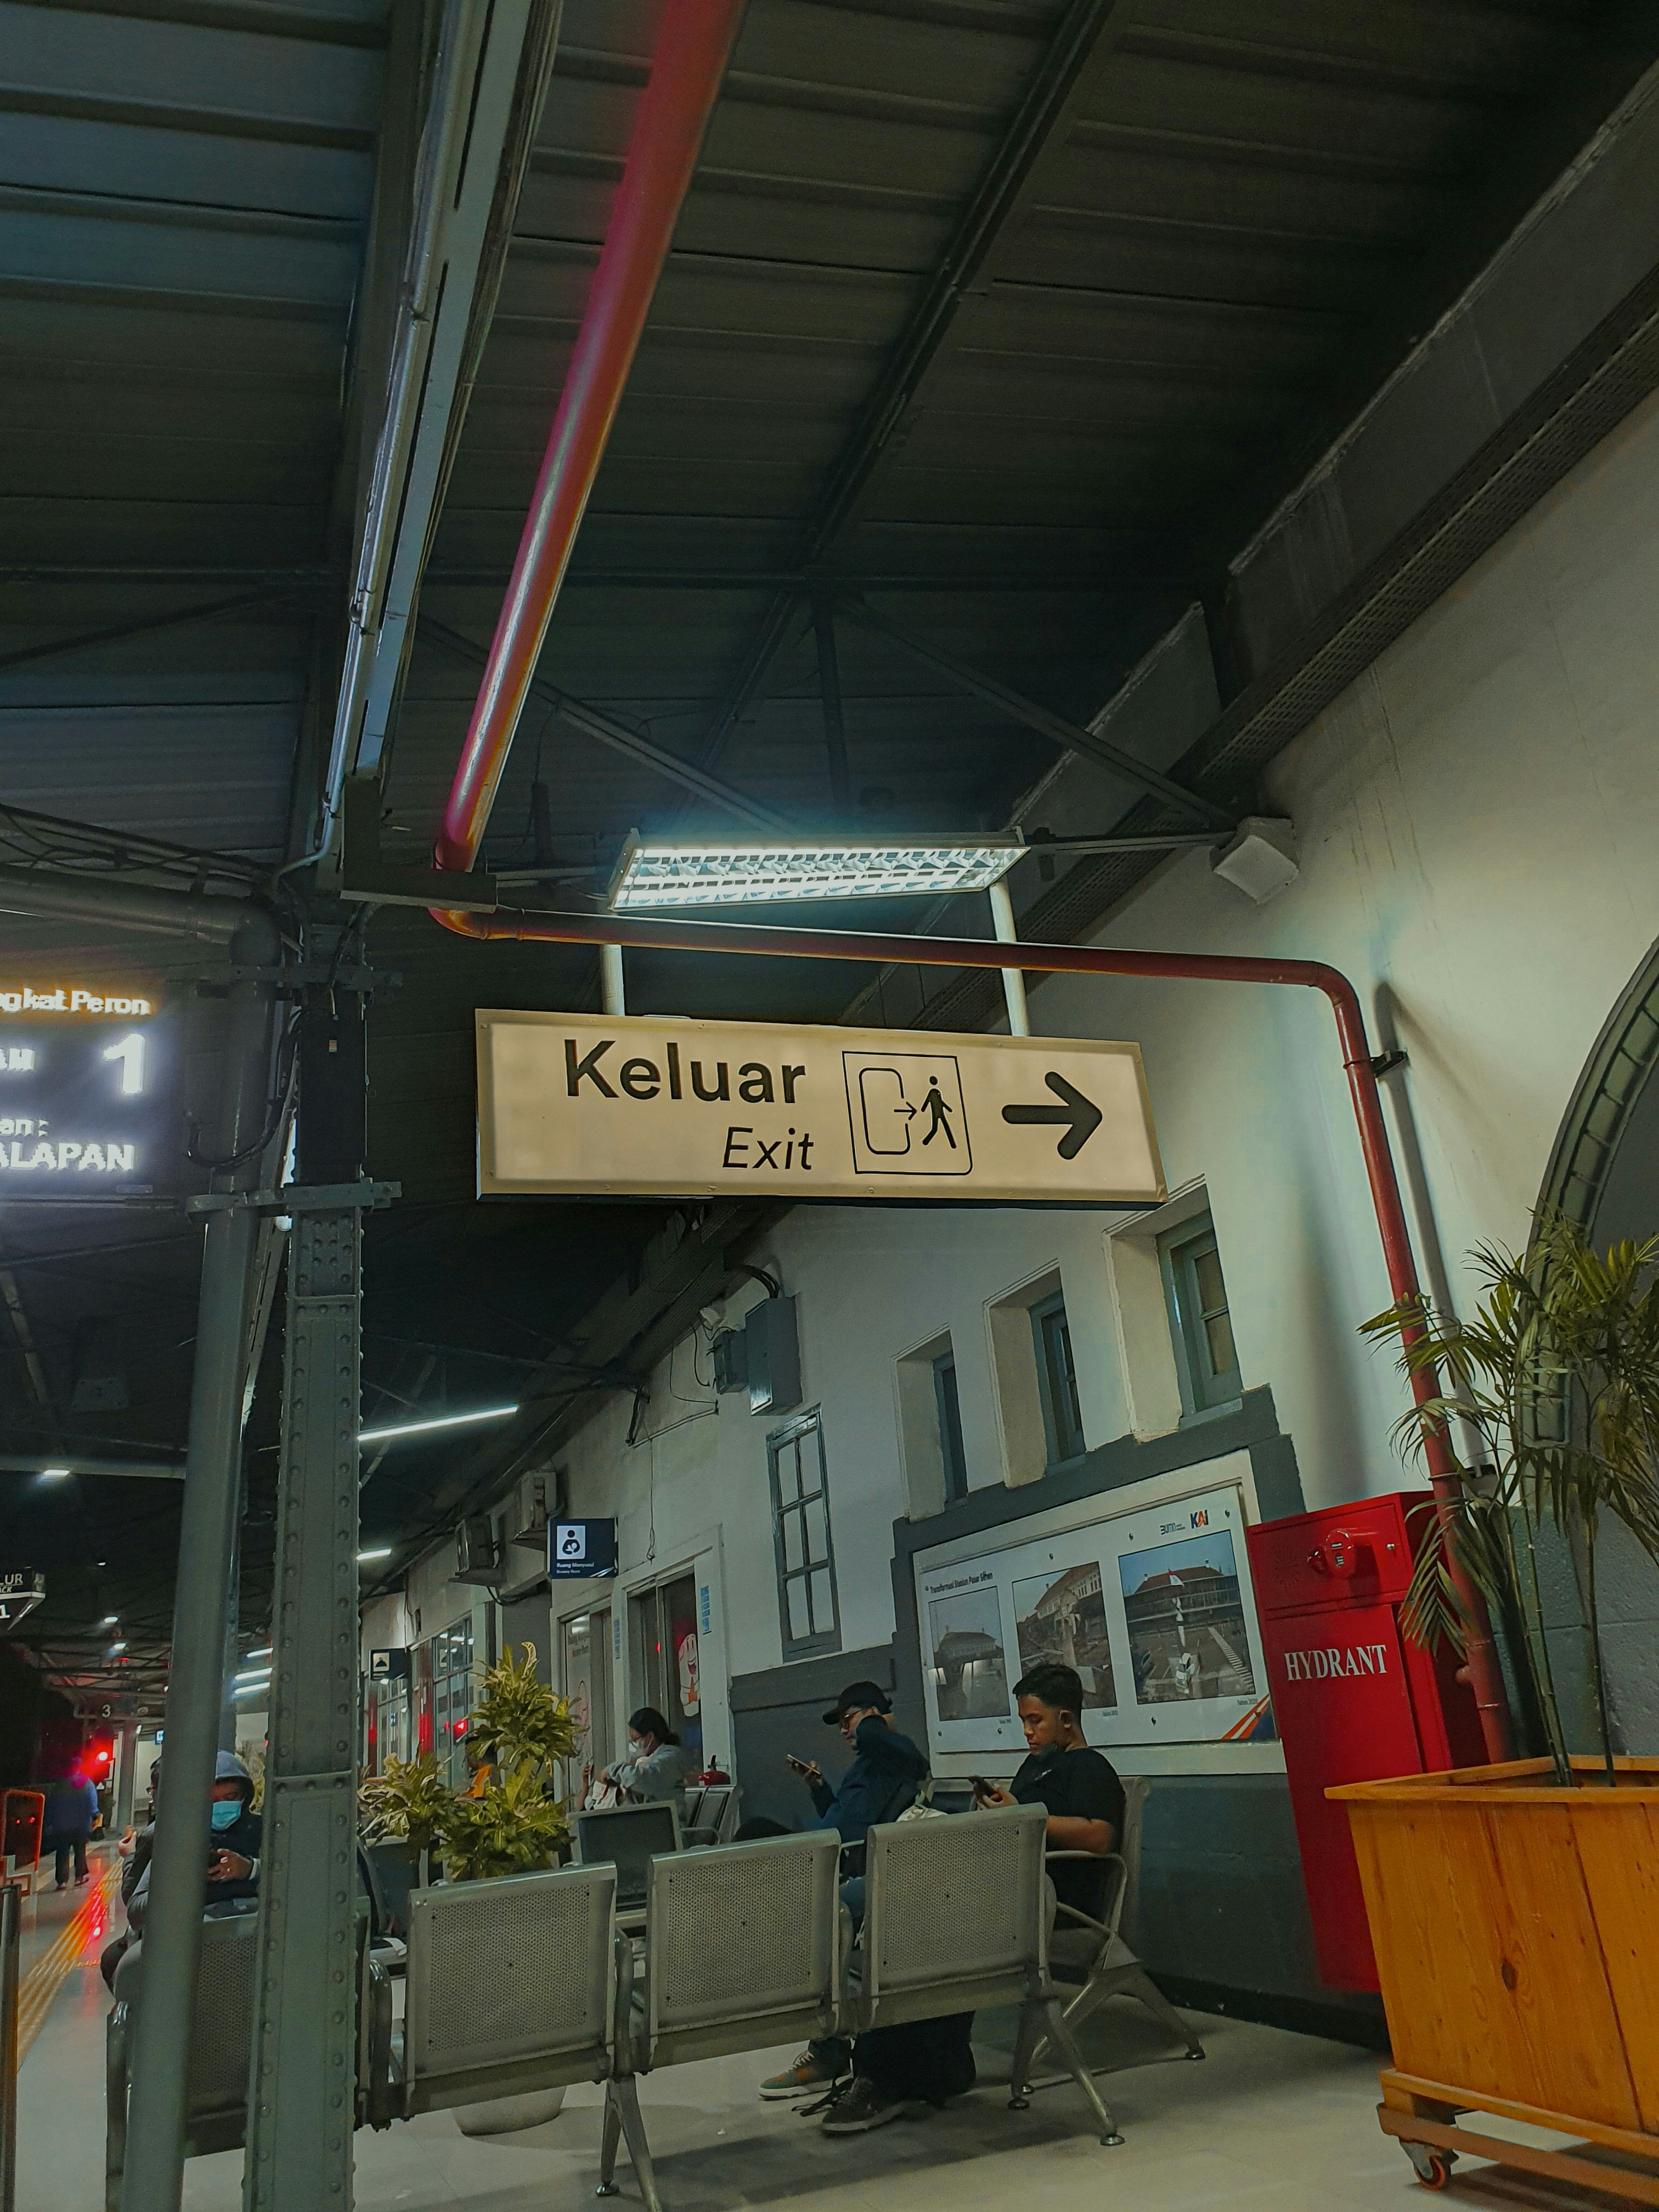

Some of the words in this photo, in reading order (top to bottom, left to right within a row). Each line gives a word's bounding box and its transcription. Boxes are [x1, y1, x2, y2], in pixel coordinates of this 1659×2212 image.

[71, 990, 151, 1015] Peron
[103, 1034, 145, 1093] 1
[564, 1039, 806, 1104] Keluar
[722, 1126, 814, 1171] Exit
[1190, 1509, 1209, 1529] KAI
[0, 1573, 23, 1585] UR
[1284, 1644, 1387, 1681] HYDRANT
[101, 1704, 111, 1718] 3
